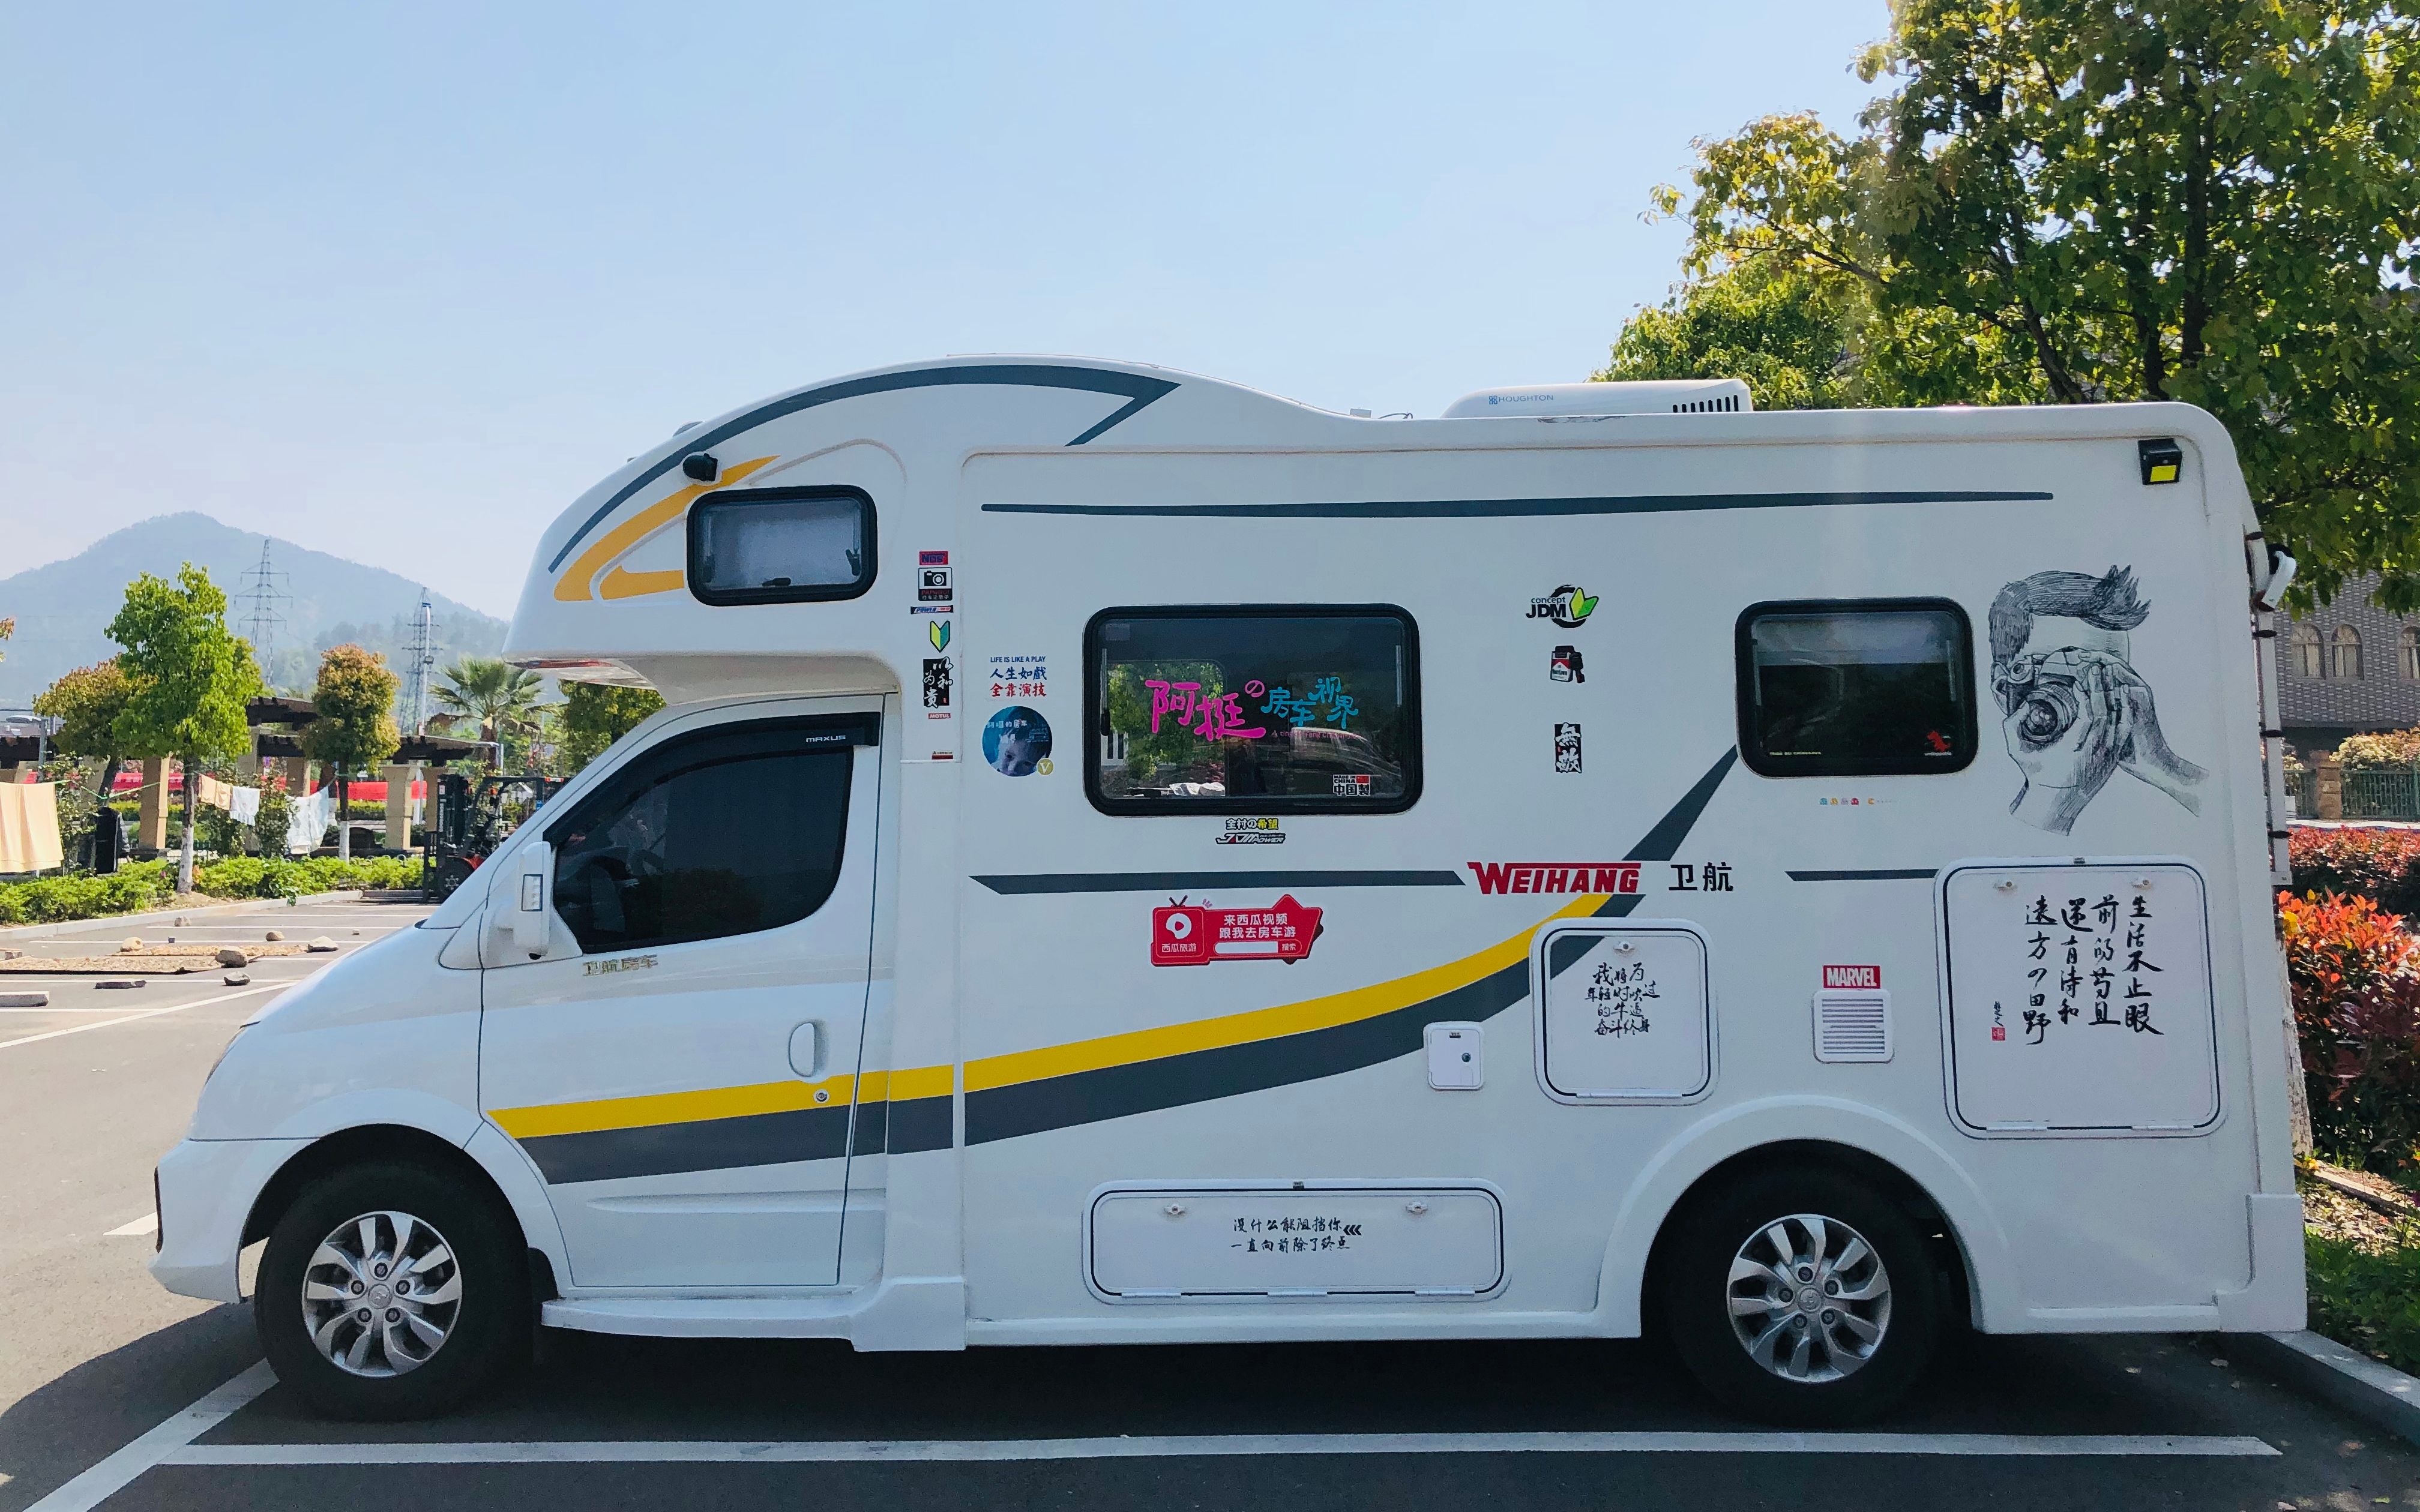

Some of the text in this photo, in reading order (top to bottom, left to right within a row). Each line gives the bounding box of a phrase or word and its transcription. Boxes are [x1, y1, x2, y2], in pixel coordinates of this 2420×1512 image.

[1498, 394, 1554, 403] HOUGHTON
[1531, 596, 1566, 605] concept
[1526, 604, 1567, 619] JDM
[990, 682, 1047, 697] 全靠演技
[1467, 862, 1734, 895] WEIHANG 卫航
[1224, 913, 1288, 926] 来西瓜视频
[1219, 926, 1296, 939] 跟我去房车游
[1161, 943, 1197, 953] 西瓜旅游
[1281, 943, 1296, 952] 搜索
[2122, 895, 2165, 1036] 生活不止眼
[1826, 967, 1877, 986] MARVEL
[1233, 1216, 1342, 1233] 没什么能阻挡你
[1230, 1235, 1350, 1253] 一直向前除了终点
